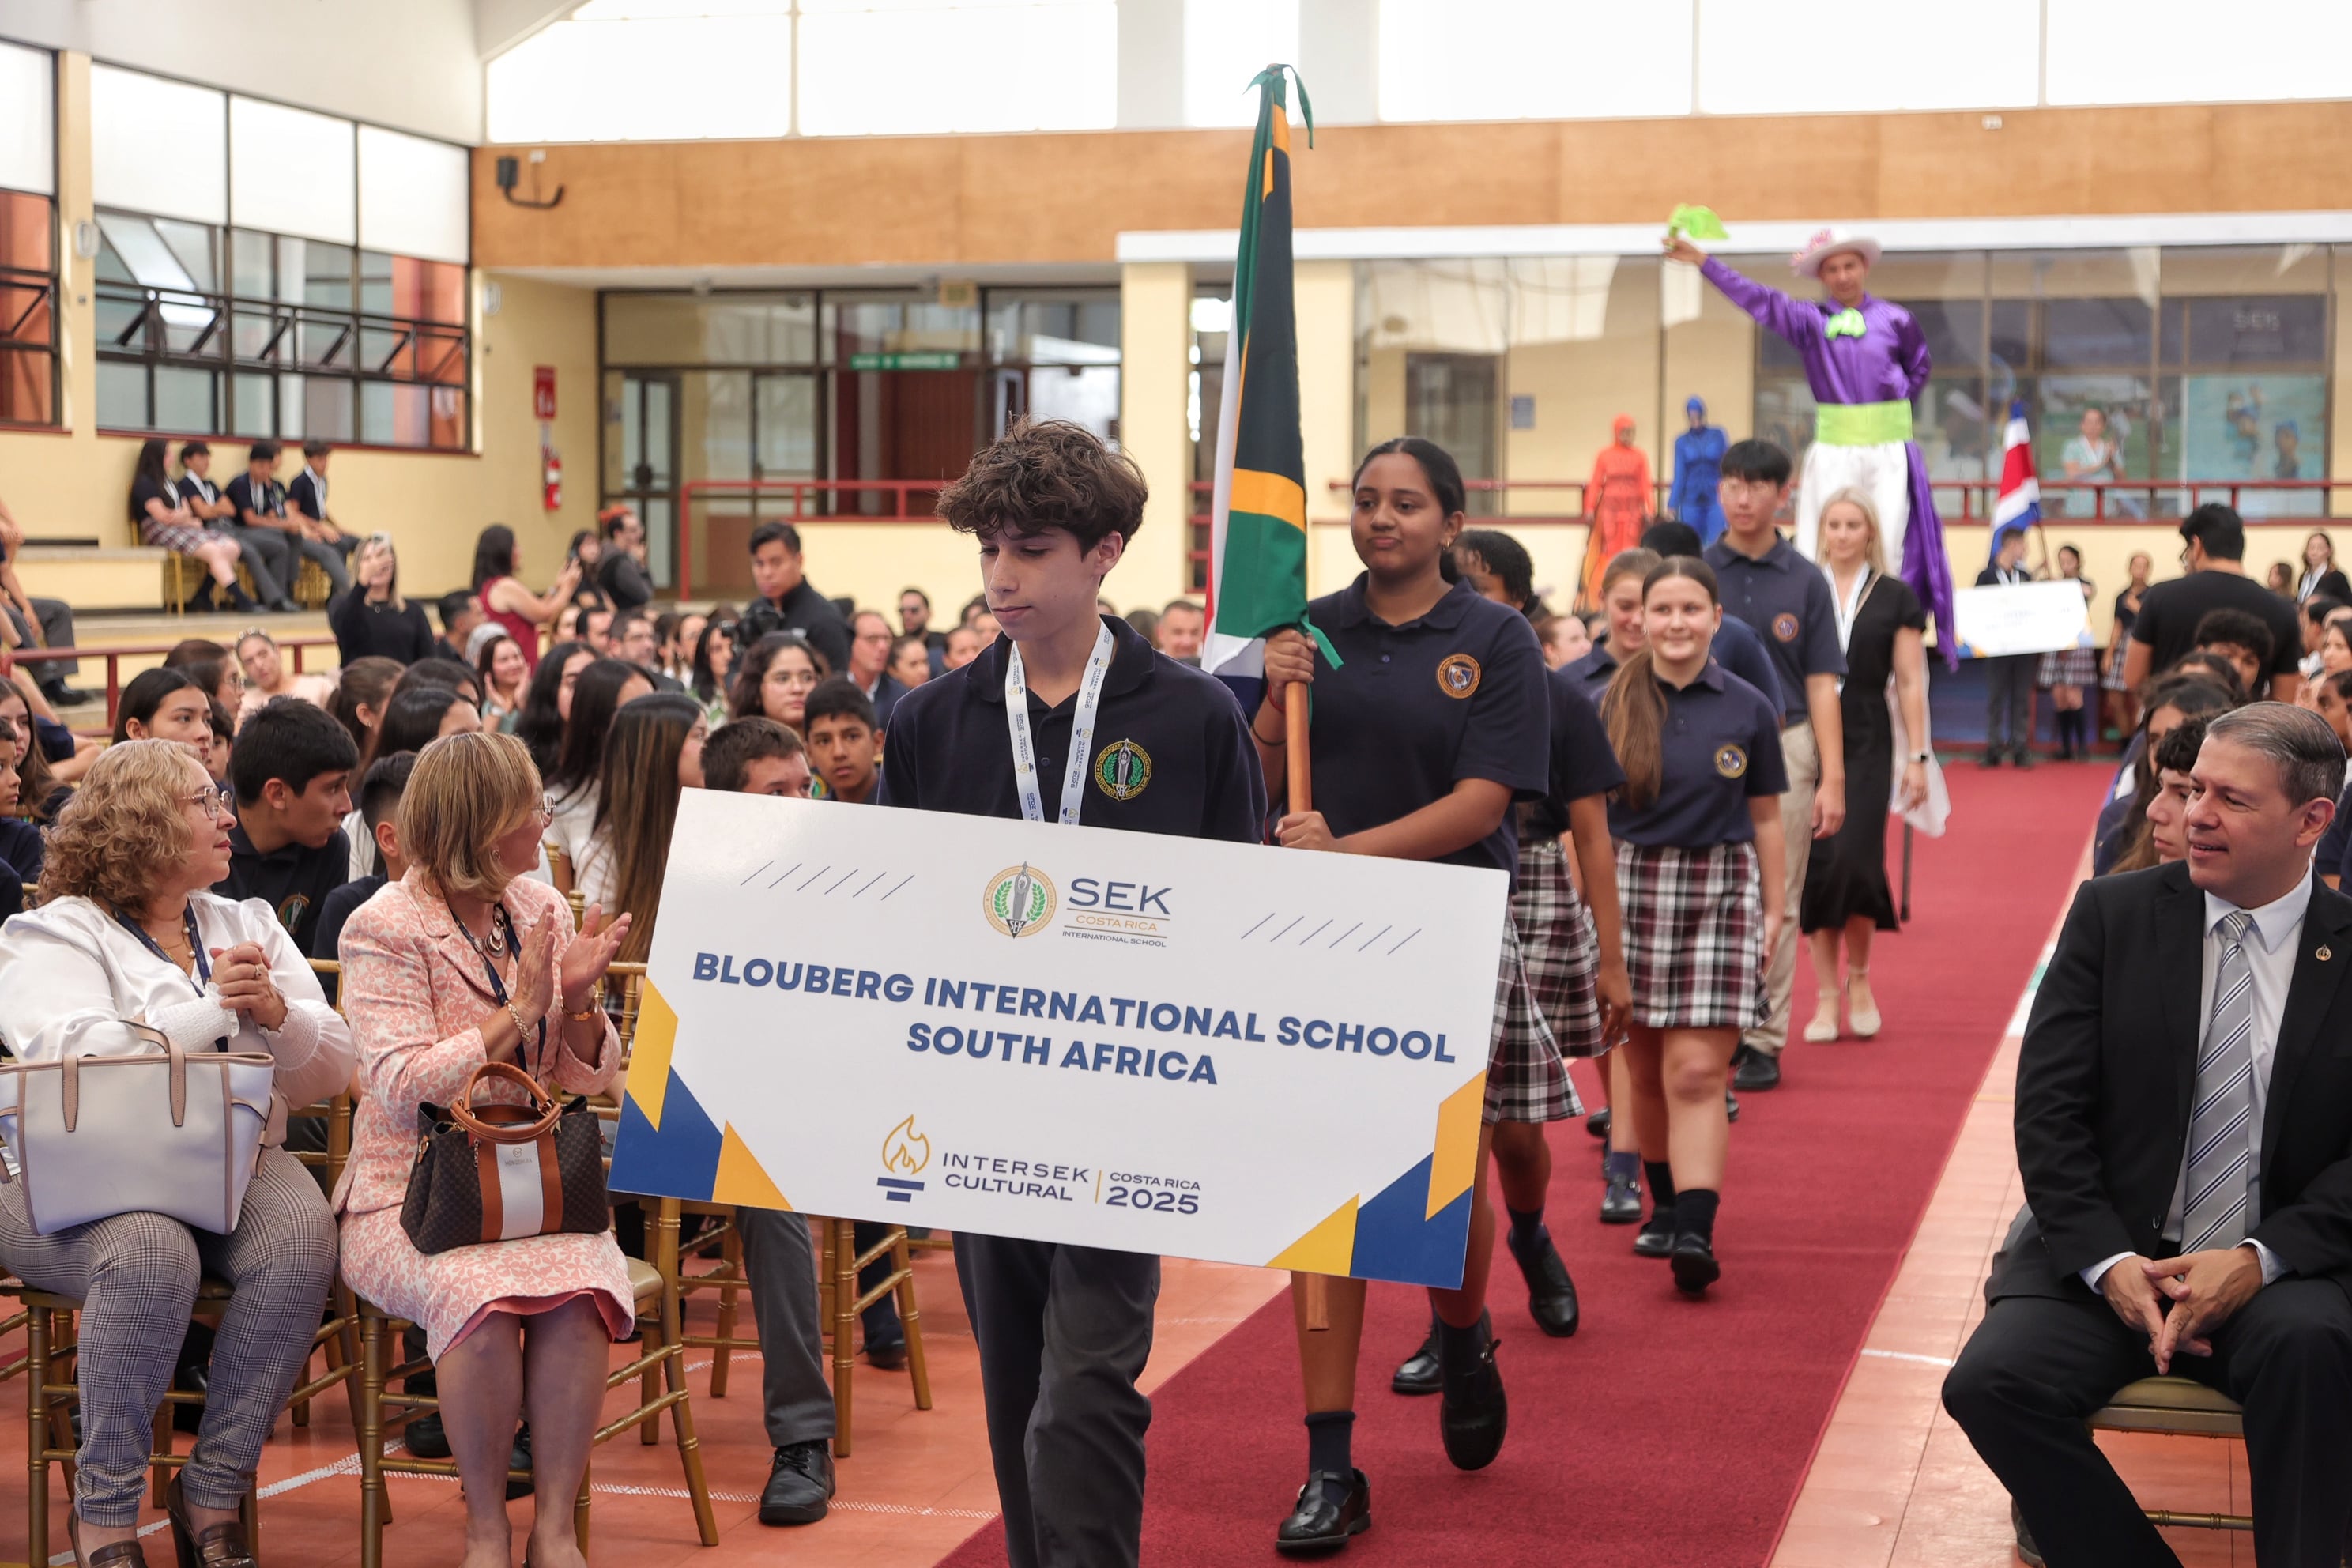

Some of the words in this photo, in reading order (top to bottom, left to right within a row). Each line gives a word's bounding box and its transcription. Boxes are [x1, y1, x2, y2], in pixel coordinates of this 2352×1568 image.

[1069, 878, 1172, 915] SEK
[1009, 920, 1024, 933] SEK
[1076, 915, 1121, 928] COSTA
[1125, 920, 1157, 931] RICA
[1062, 931, 1129, 944] INTERNATIONAL
[1130, 938, 1167, 948] SCHOOL
[692, 952, 914, 1002] BLOUBERG
[924, 978, 1265, 1042] INTERNATIONAL
[1277, 1016, 1455, 1063] SCHOOL
[906, 1023, 1051, 1065] SOUTH
[1059, 1041, 1218, 1085] AFRICA
[943, 1152, 1090, 1183] INTERSEK
[1110, 1172, 1161, 1186] COSTA
[1164, 1178, 1200, 1191] RICA
[945, 1174, 1073, 1201] CULTURAL
[1106, 1186, 1199, 1215] 2025
